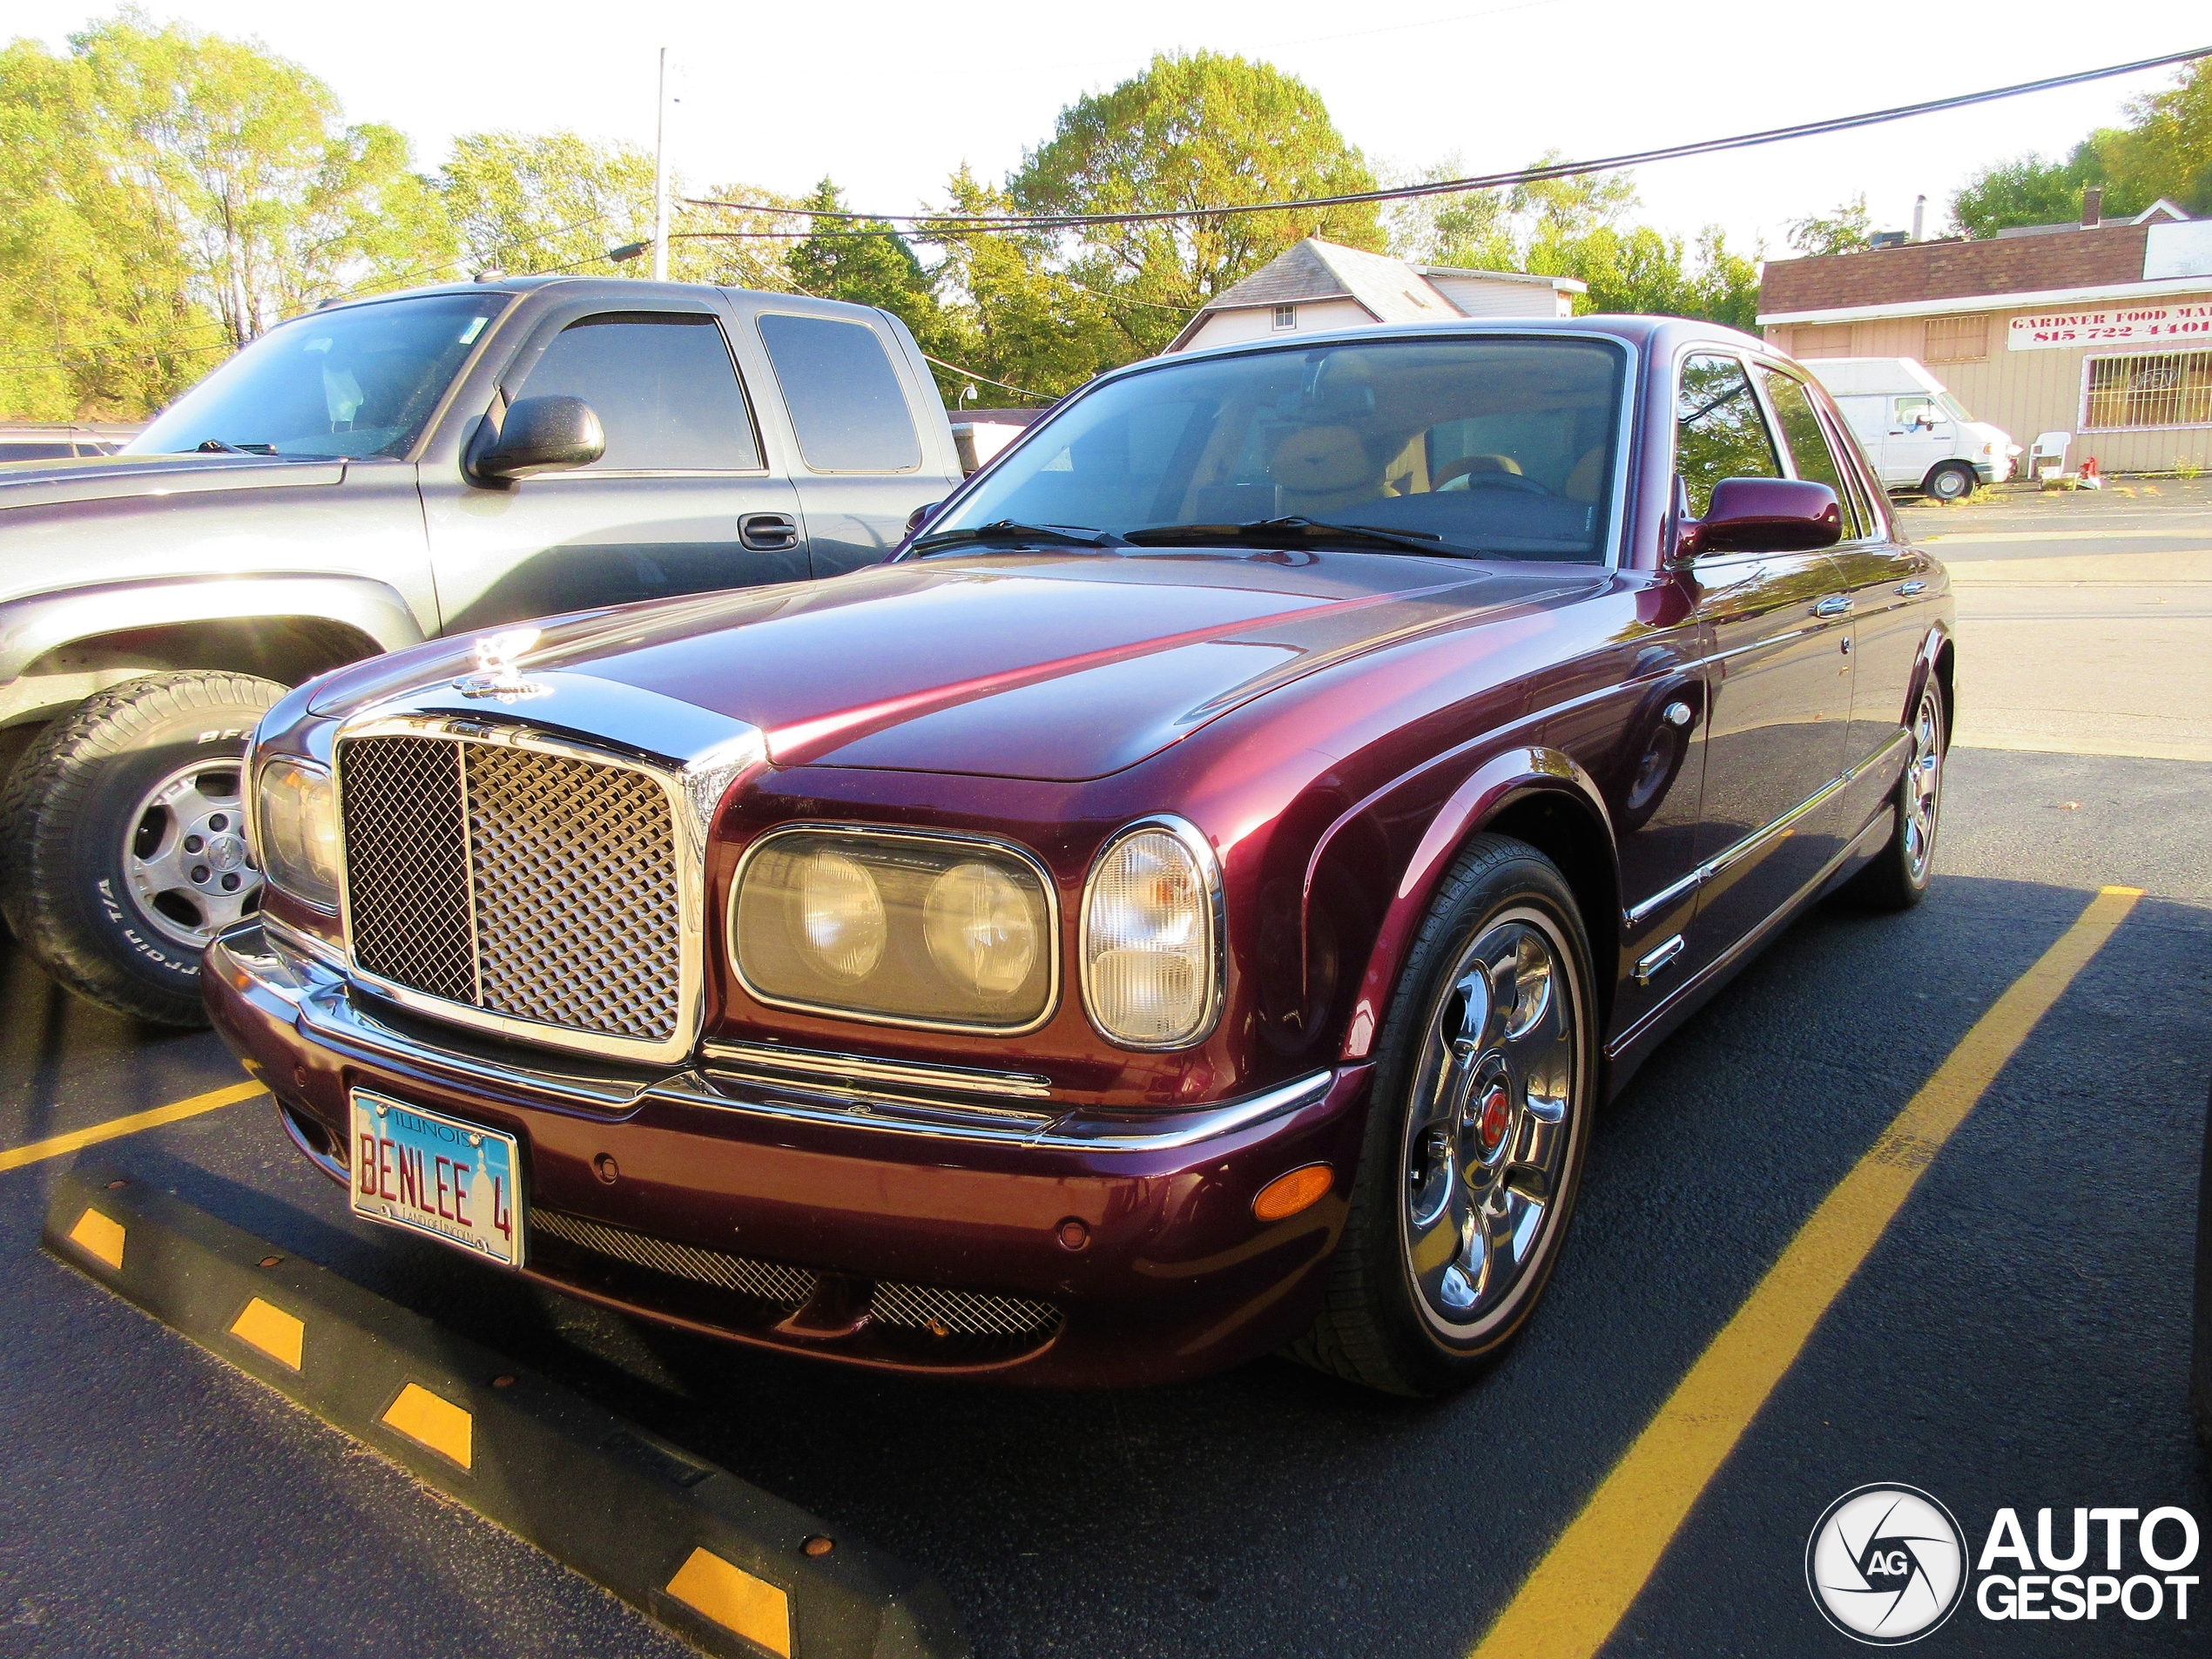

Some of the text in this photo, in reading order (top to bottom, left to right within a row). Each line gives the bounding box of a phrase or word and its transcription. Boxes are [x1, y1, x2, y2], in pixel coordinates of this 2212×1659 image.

[2012, 307, 2212, 329] GARDNER FOOD MA
[2033, 320, 2210, 342] 815-722-4401
[2129, 372, 2172, 388] OPEN
[98, 879, 124, 923] T/A
[125, 929, 201, 976] rrain
[395, 1111, 472, 1148] ILLINOIS
[361, 1133, 512, 1242] BENLEE 4
[402, 1207, 474, 1244] LAND OF LINCOLN
